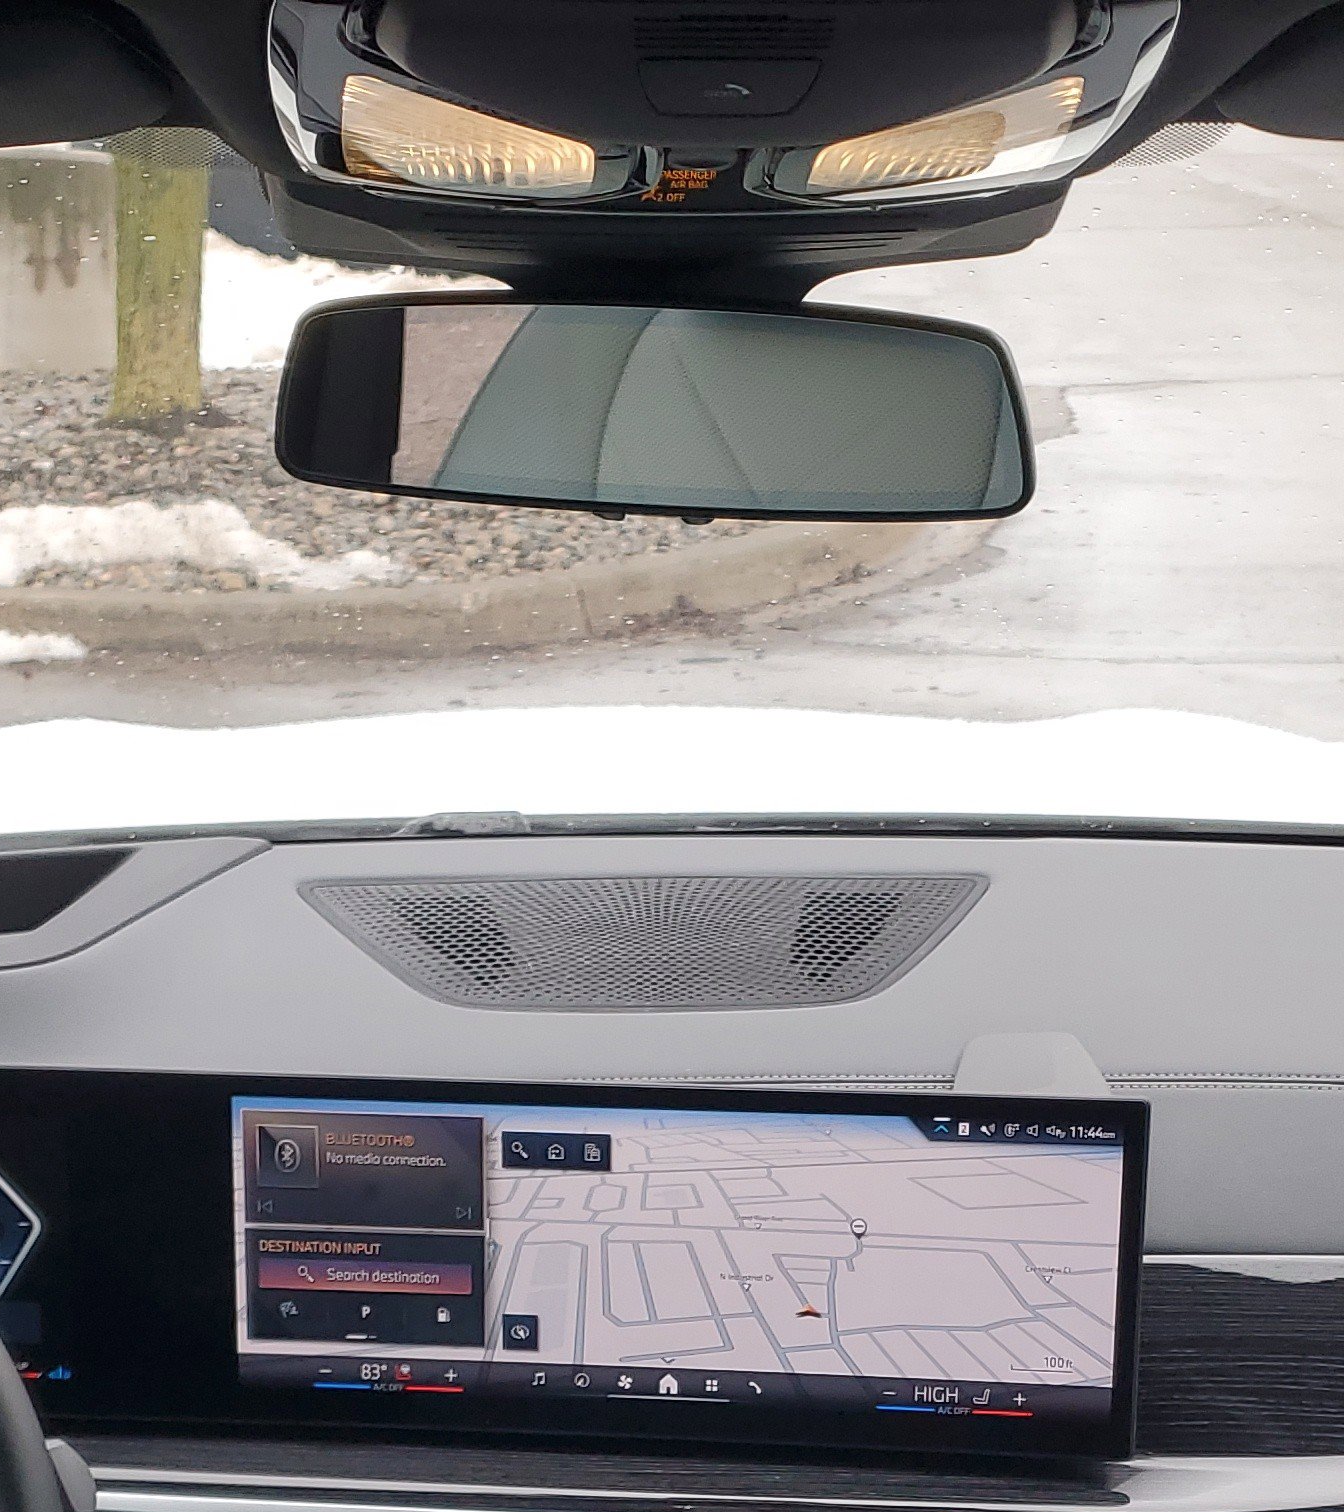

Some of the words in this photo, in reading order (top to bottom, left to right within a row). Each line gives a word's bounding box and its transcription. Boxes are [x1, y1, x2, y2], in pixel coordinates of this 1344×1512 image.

[666, 193, 686, 202] OFF
[1069, 1126, 1103, 1139] 11:44
[325, 1151, 343, 1165] No
[259, 1239, 343, 1254] DESTINATION
[343, 1242, 381, 1255] INPUT
[326, 1267, 368, 1283] Search
[372, 1269, 440, 1284] destination
[361, 1305, 371, 1319] P
[914, 1385, 959, 1404] HIGH
